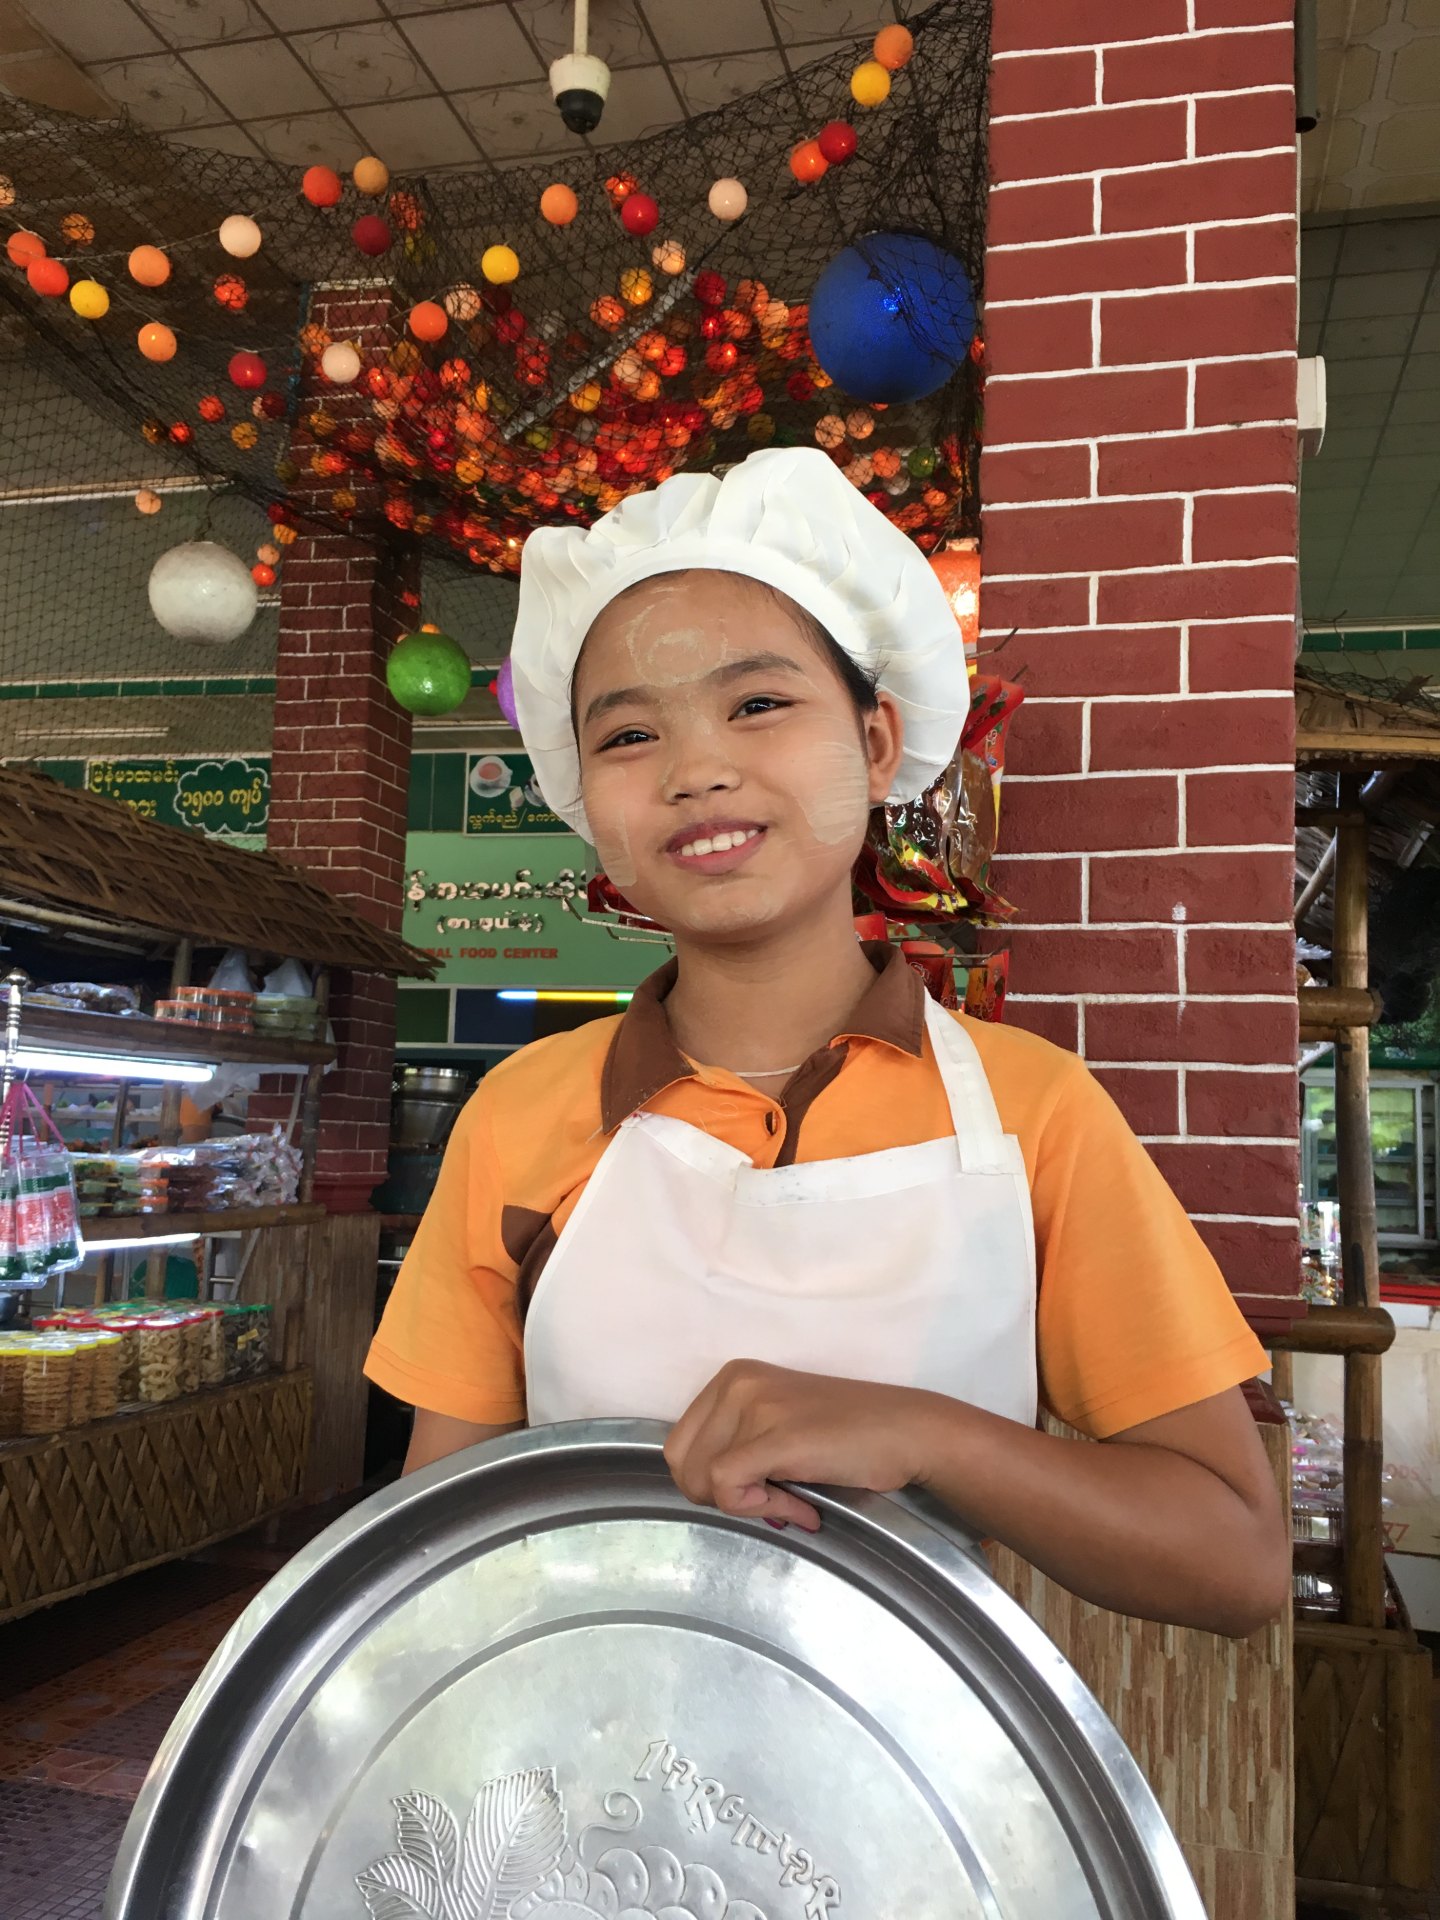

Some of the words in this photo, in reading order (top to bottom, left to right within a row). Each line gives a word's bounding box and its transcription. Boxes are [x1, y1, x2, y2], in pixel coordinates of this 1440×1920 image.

[229, 777, 262, 815] ကျပ်
[459, 947, 497, 959] FOOD
[504, 947, 559, 959] CENTER
